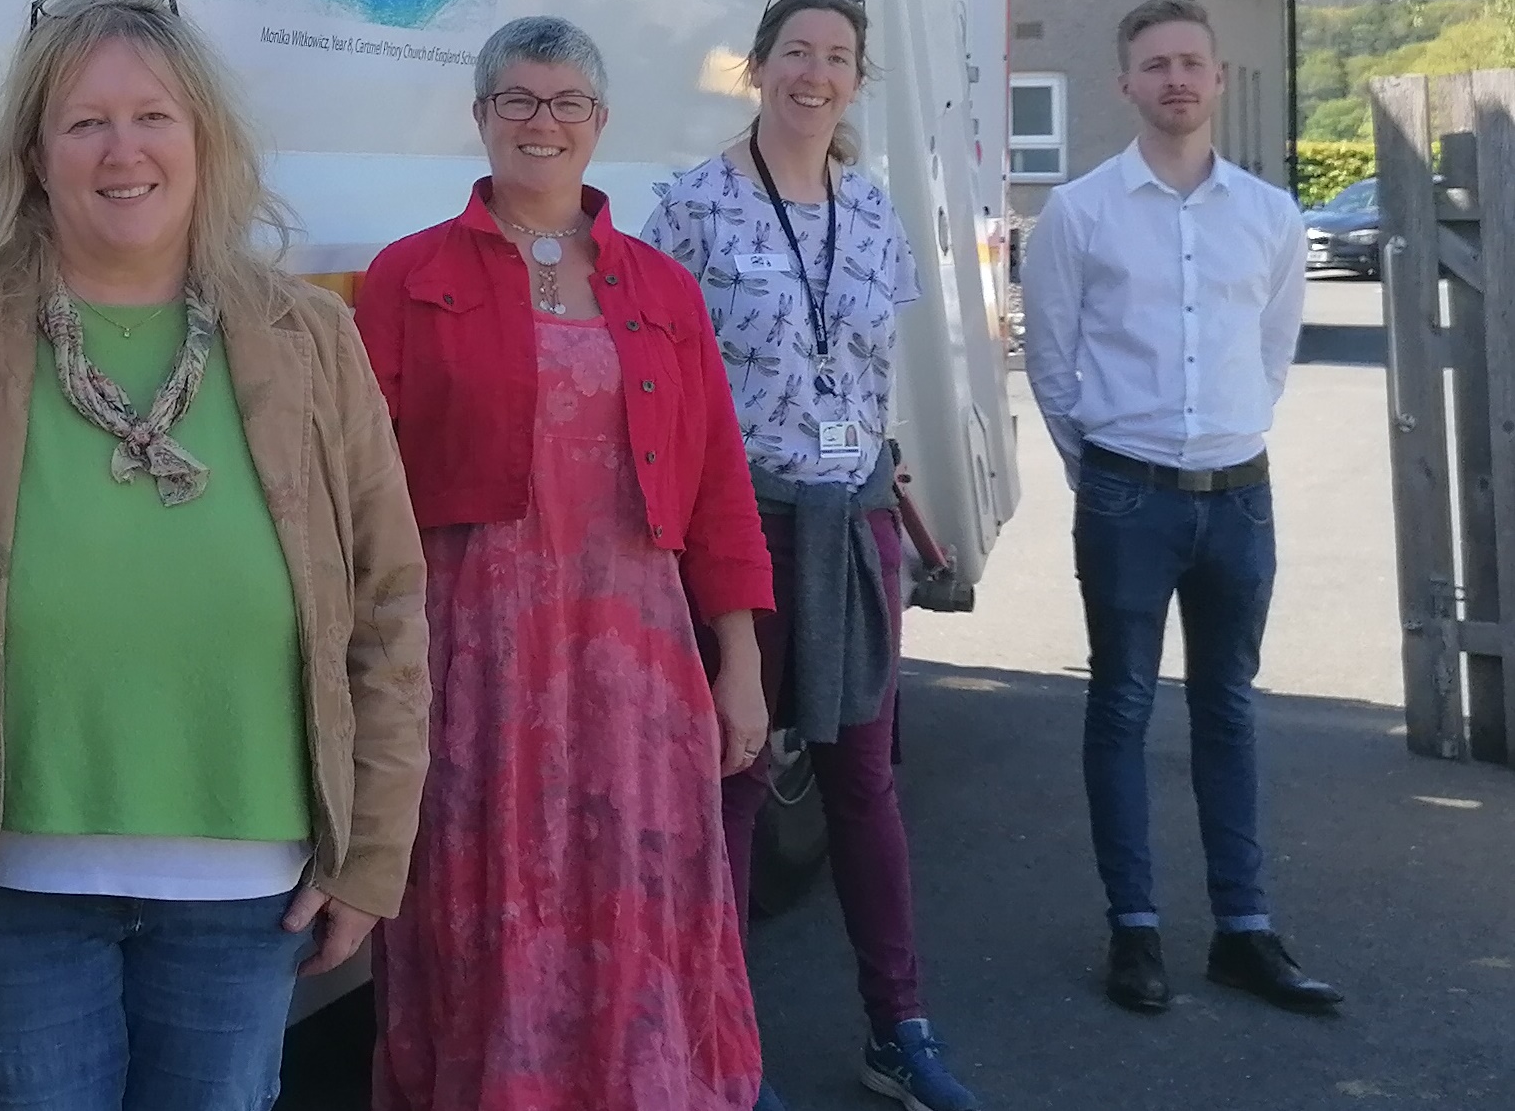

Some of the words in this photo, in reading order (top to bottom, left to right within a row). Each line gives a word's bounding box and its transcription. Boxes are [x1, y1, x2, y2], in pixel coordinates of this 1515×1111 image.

[260, 26, 291, 45] Monika
[331, 35, 347, 51] Year
[355, 38, 383, 55] Cartmel
[383, 41, 404, 61] Priory
[404, 43, 427, 60] Church
[426, 46, 436, 61] of
[435, 47, 461, 66] England
